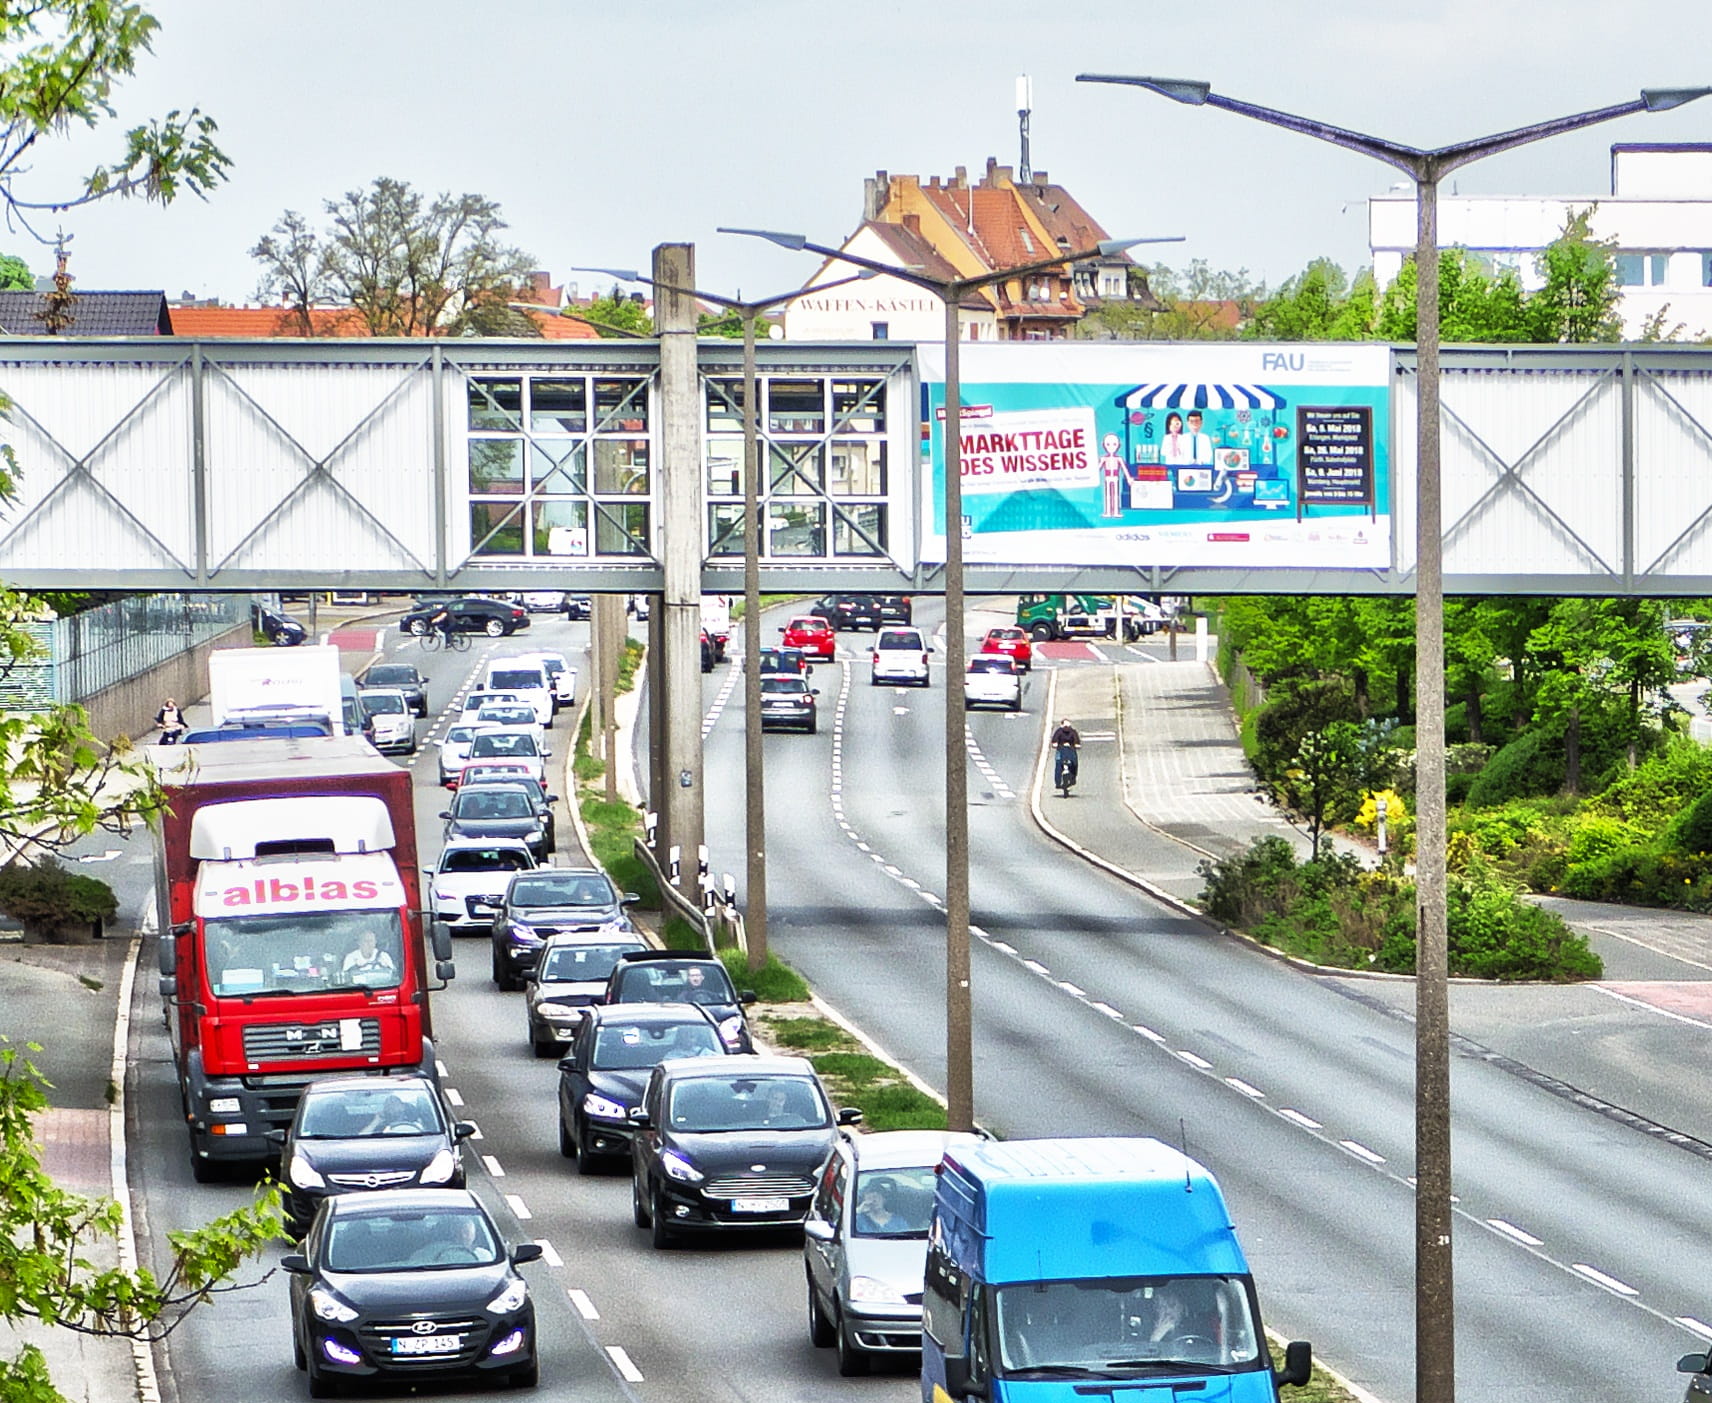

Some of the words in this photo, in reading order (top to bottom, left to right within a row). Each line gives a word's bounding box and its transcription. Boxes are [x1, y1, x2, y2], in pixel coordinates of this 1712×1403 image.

[1262, 353, 1304, 371] FAU
[960, 428, 1085, 454] MARKTTAGE
[960, 456, 994, 476] DES
[1001, 451, 1087, 474] WISSENS
[1116, 533, 1149, 541] adidas
